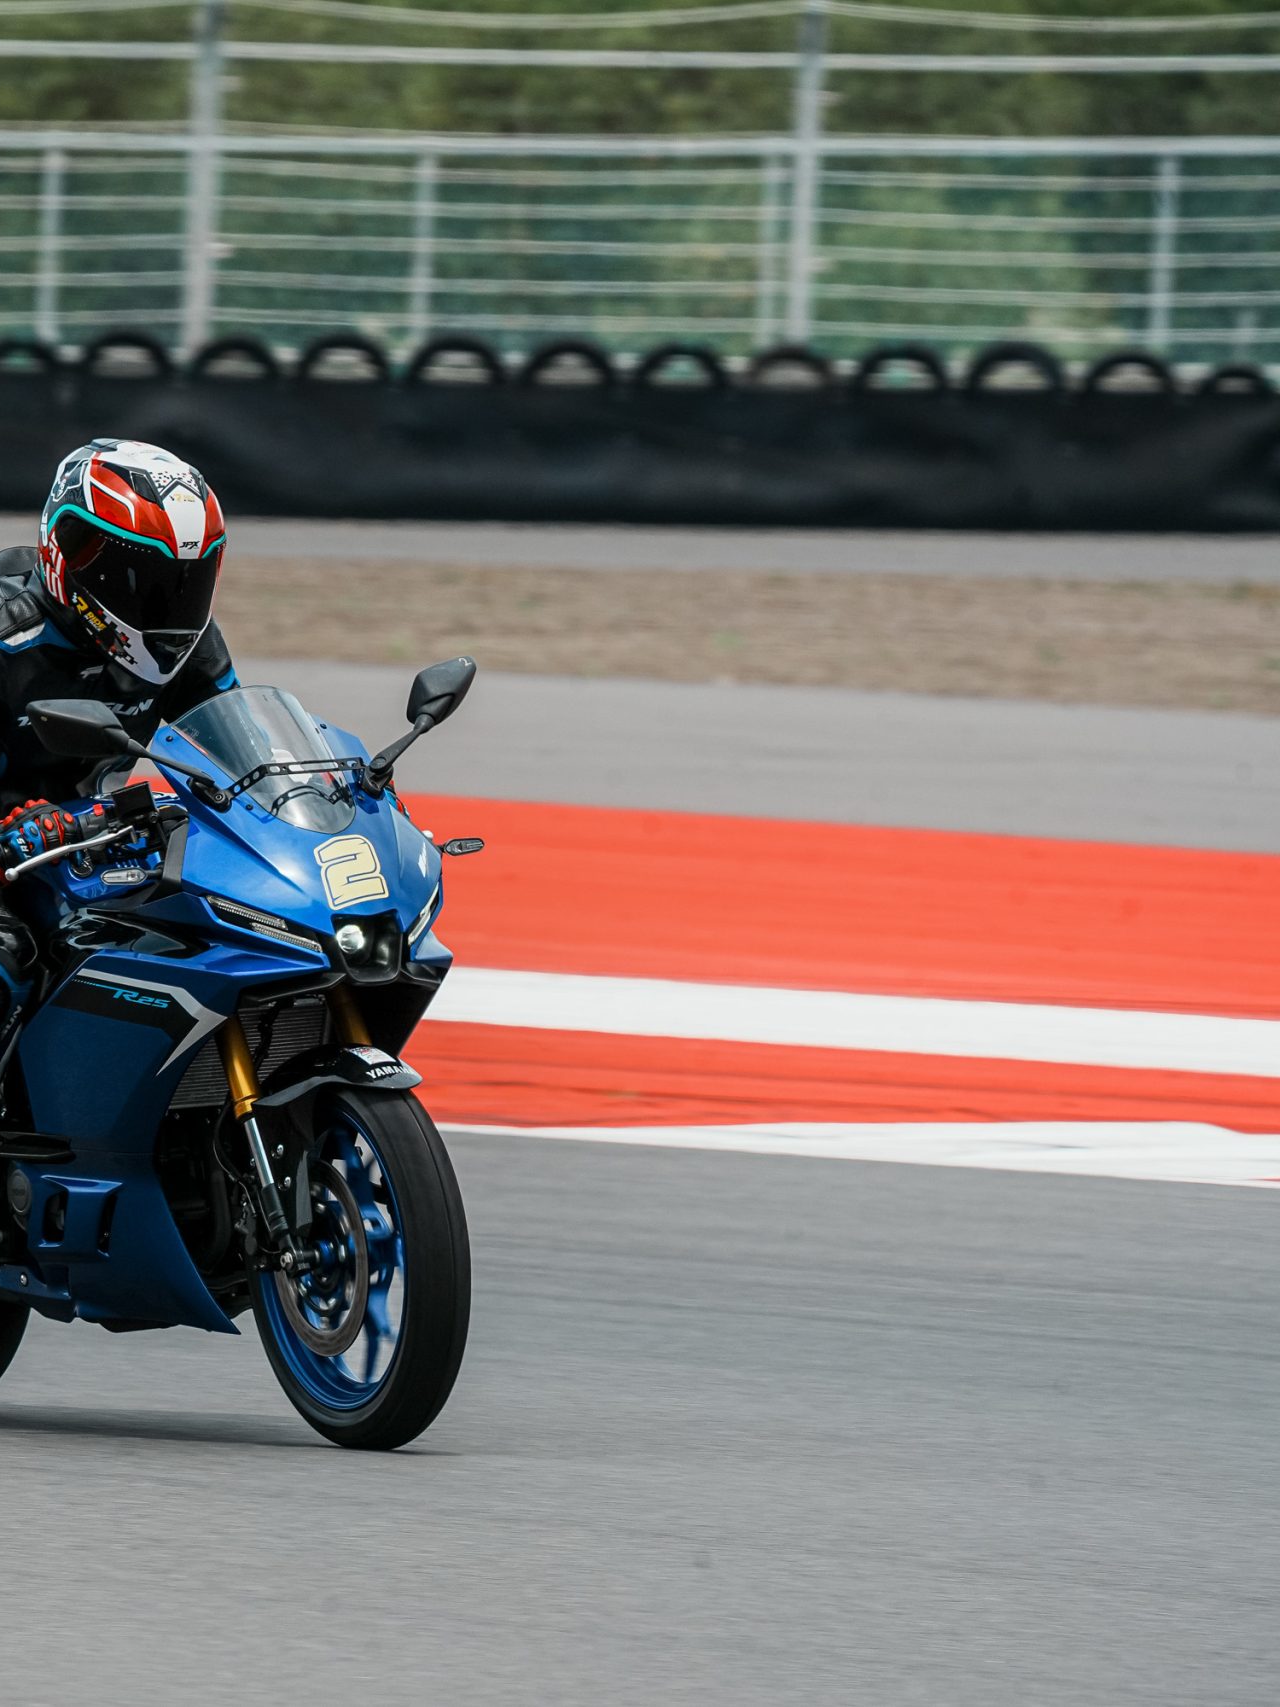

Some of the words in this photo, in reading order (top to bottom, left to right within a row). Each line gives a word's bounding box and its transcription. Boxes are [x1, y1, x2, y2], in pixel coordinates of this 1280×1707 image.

[179, 540, 200, 550] JPX
[314, 834, 389, 911] 2
[96, 984, 172, 1009] R25
[365, 1065, 411, 1079] YAMAH
